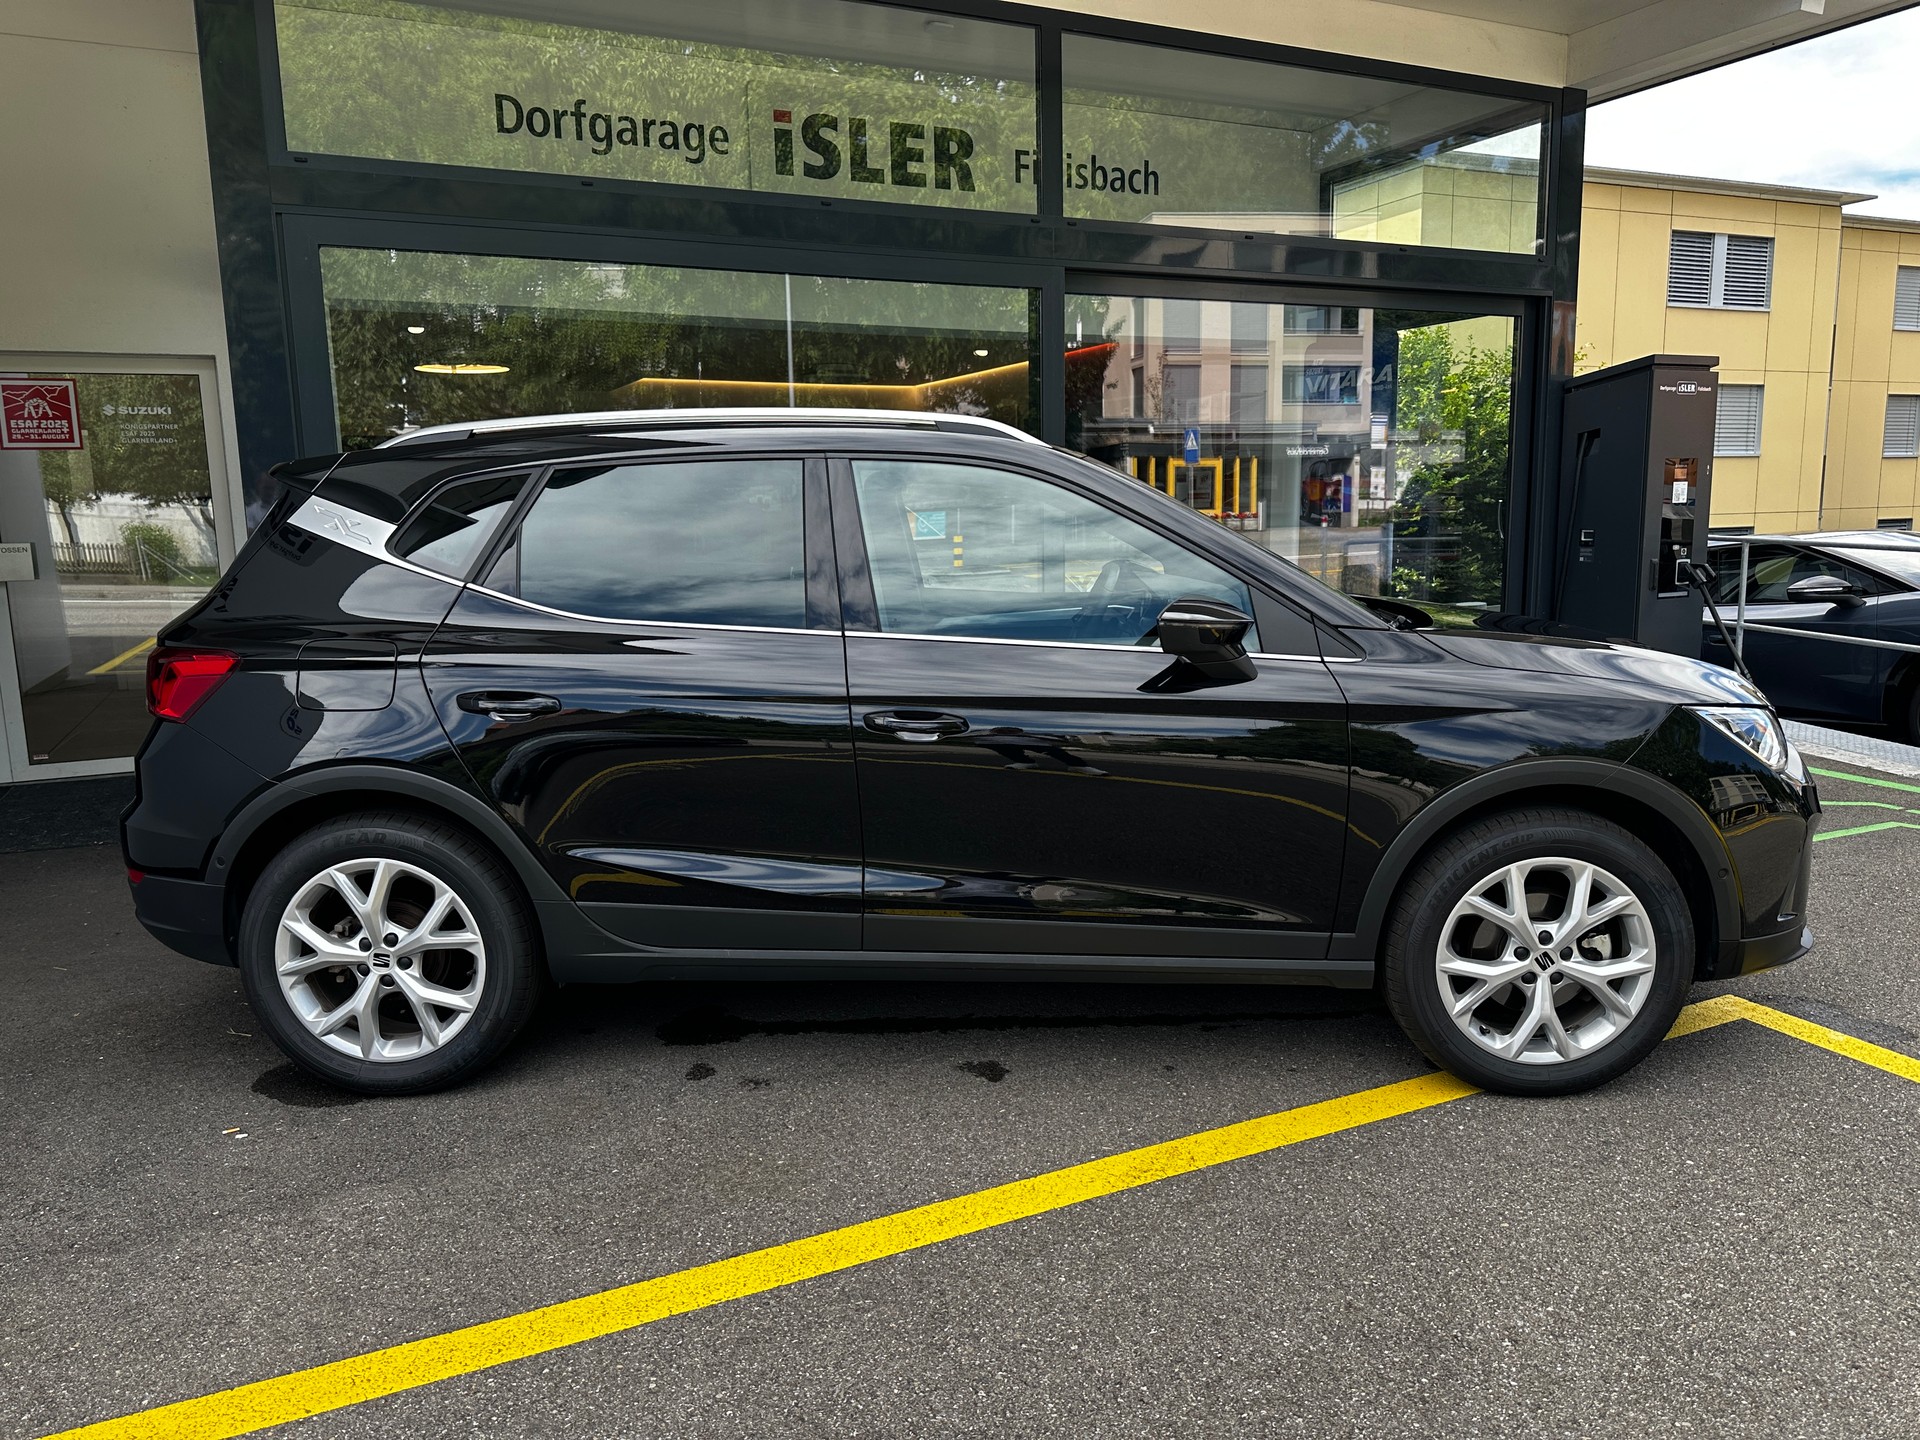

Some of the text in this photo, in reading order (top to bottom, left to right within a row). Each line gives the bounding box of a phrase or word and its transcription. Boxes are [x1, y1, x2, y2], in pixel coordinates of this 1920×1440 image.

[494, 93, 1160, 196] Dorfgarage iSLER Fiisbach
[1305, 364, 1393, 393] VITARA
[118, 406, 172, 415] SUZUKI
[10, 420, 69, 429] ESAF 2025
